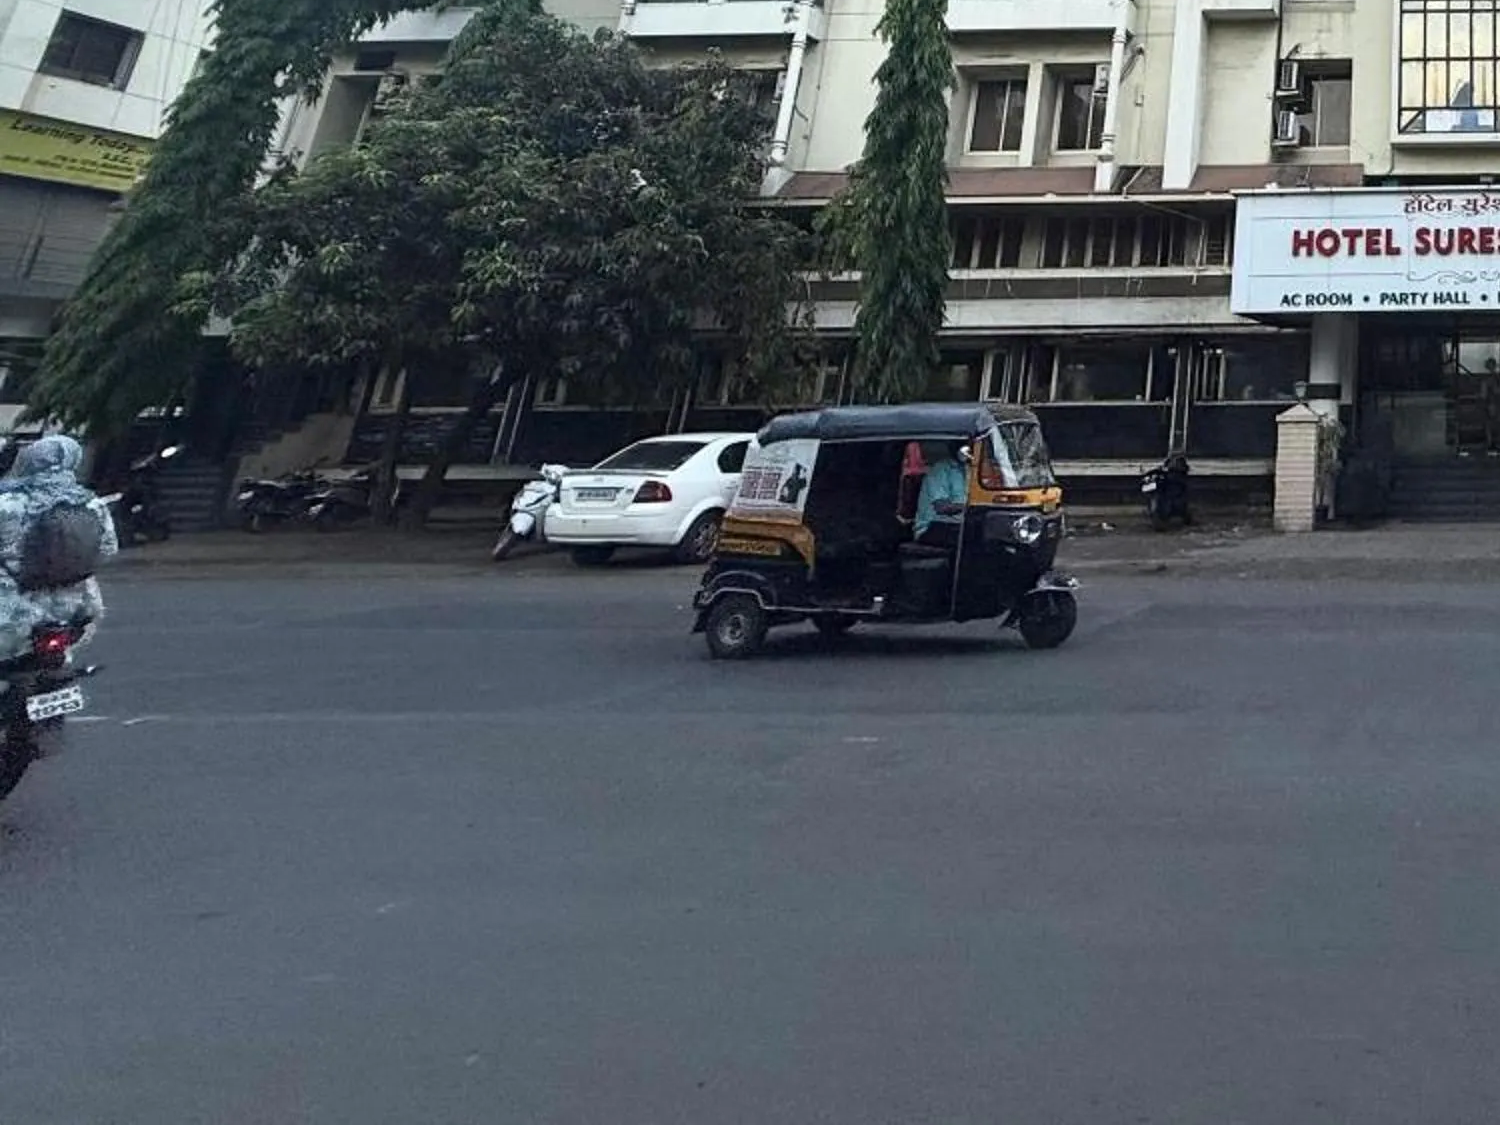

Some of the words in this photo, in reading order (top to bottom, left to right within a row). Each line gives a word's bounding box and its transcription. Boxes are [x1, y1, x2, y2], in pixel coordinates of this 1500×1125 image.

[1292, 228, 1401, 257] HOTEL
[1280, 293, 1301, 306] AC
[1305, 292, 1353, 306] ROOM
[1379, 292, 1429, 305] PARTY
[1433, 291, 1470, 304] HALL
